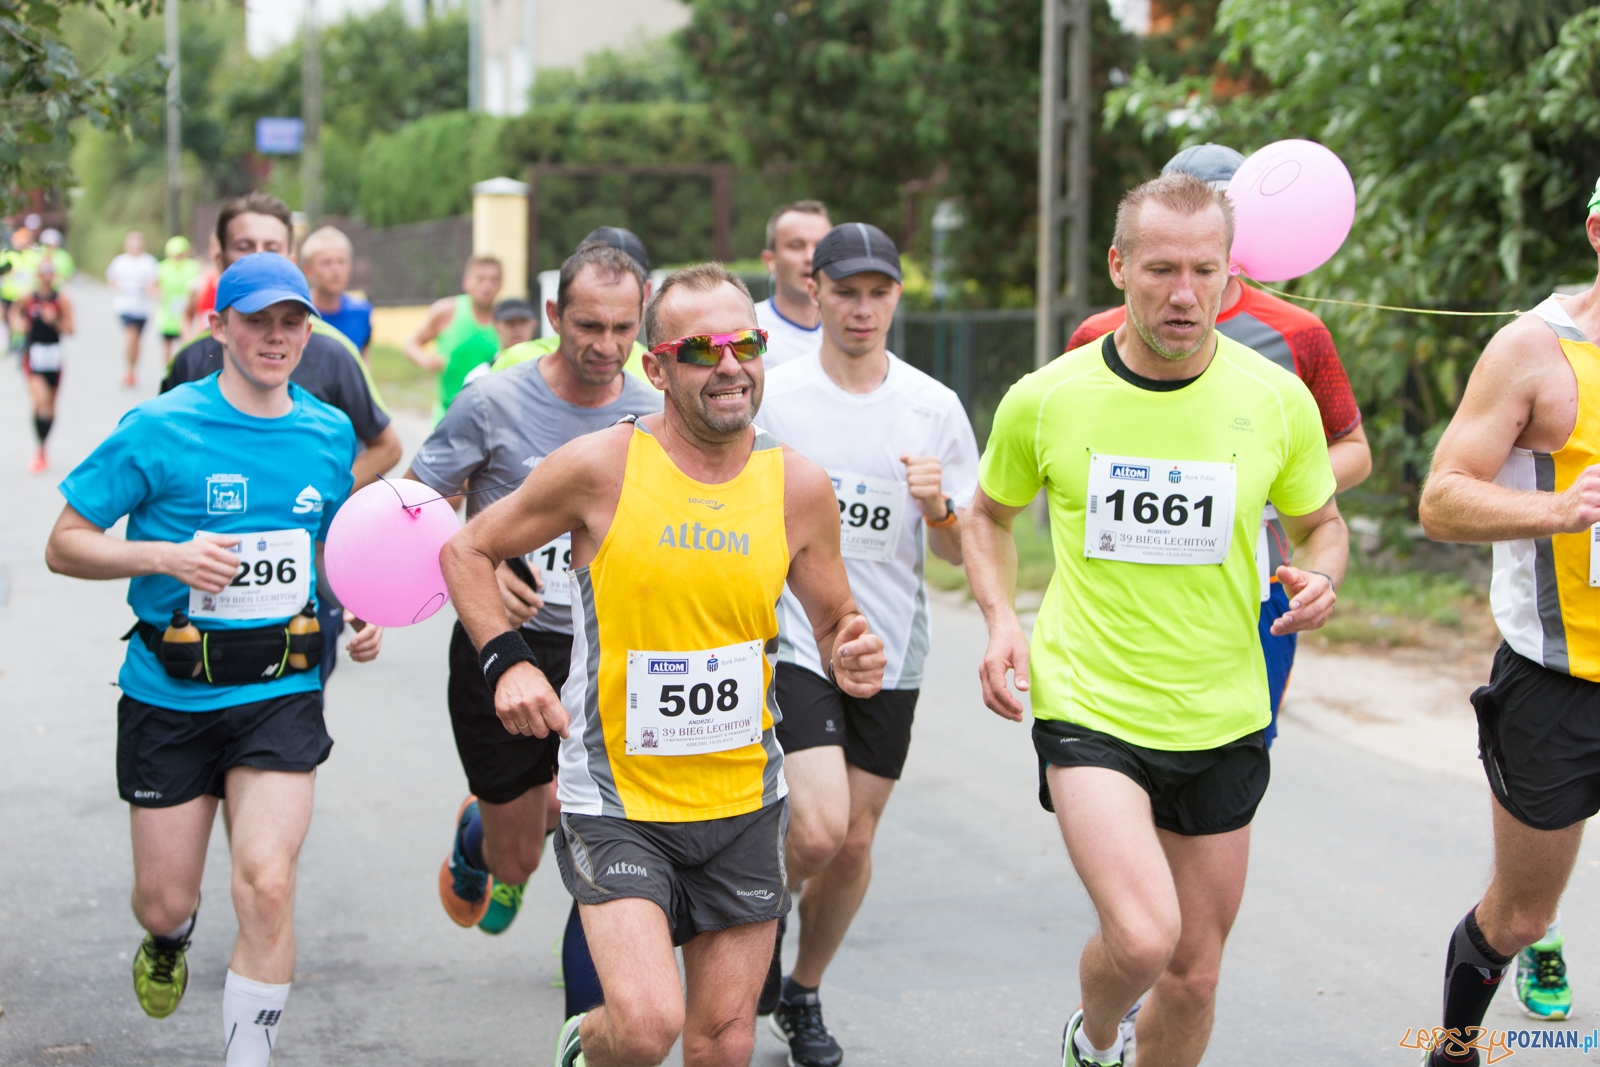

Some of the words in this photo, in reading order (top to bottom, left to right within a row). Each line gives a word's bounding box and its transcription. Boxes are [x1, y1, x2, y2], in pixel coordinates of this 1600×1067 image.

[688, 497, 718, 506] saucony
[1105, 489, 1213, 527] 1661
[1120, 533, 1133, 543] 39
[1135, 535, 1161, 545] BIEG
[1164, 536, 1218, 547] LECHITÓW
[228, 558, 296, 586] 296
[218, 595, 230, 603] 39
[721, 658, 733, 666] Bank
[733, 655, 748, 663] Polski
[658, 678, 739, 717] 508
[662, 728, 676, 737] 39
[679, 726, 704, 736] BIEG
[706, 716, 753, 734] LECHITÓW
[688, 718, 715, 726] ANDRZEJ
[736, 889, 768, 897] saucony
